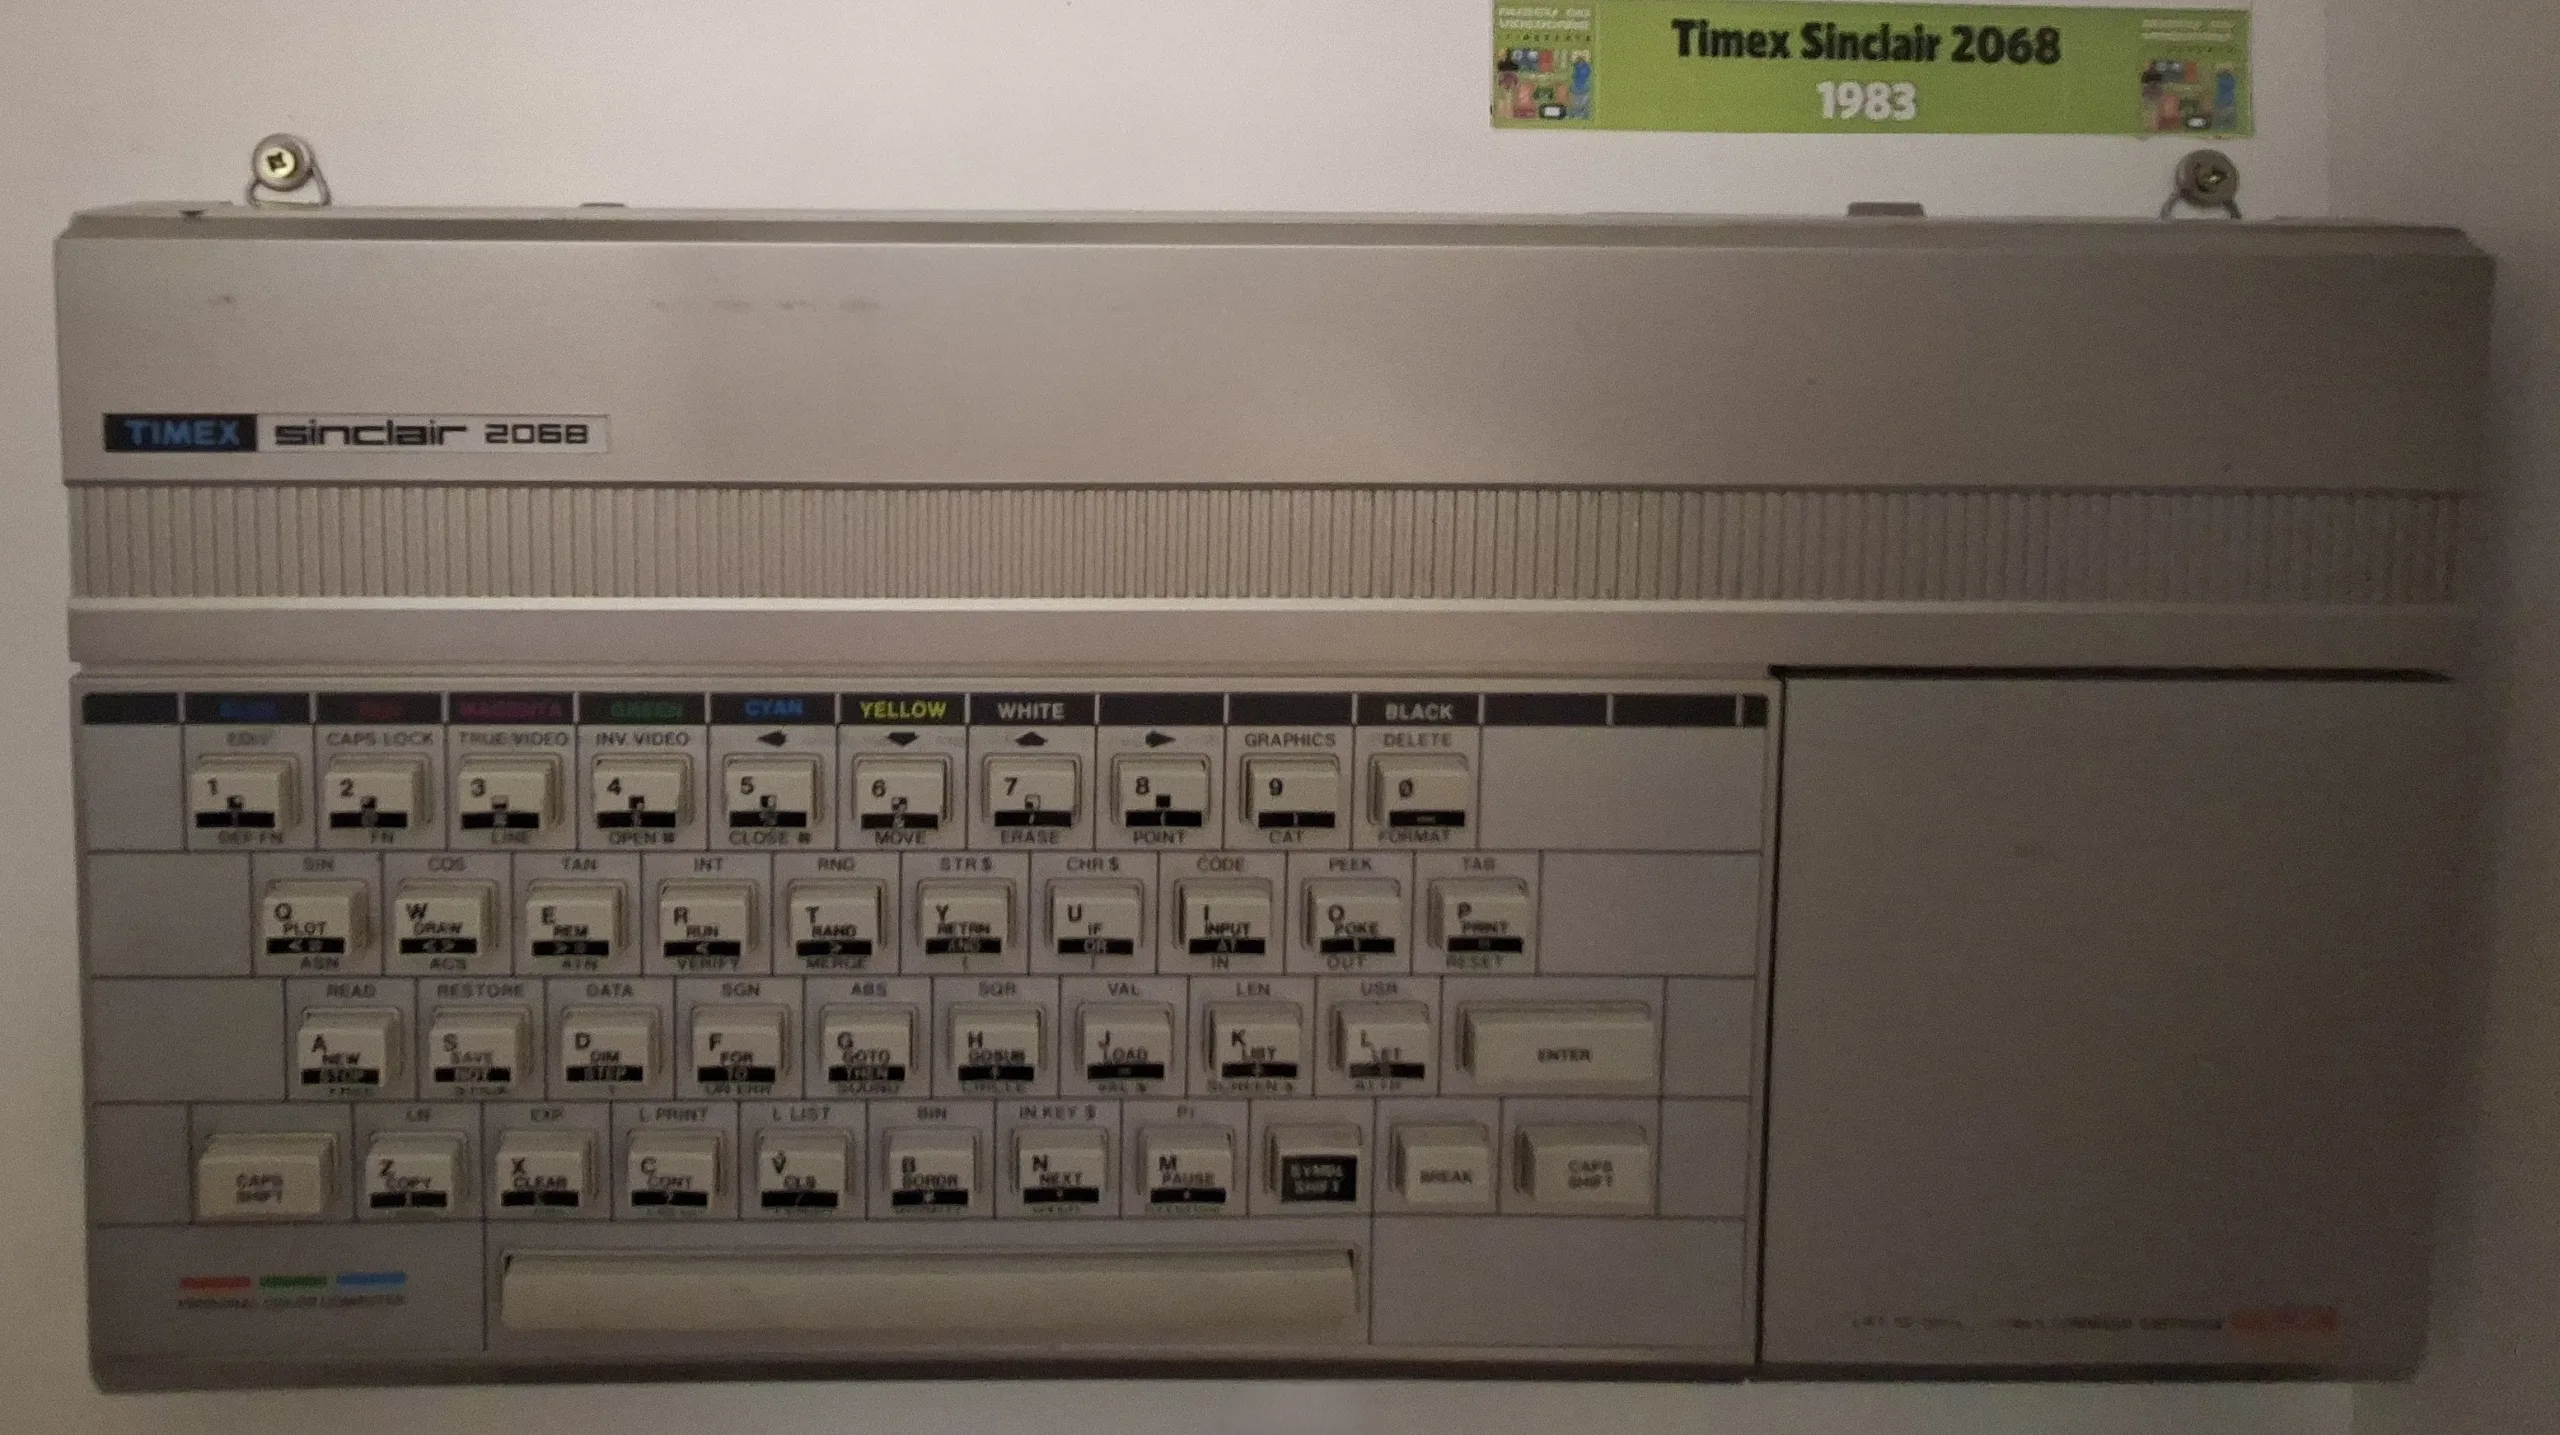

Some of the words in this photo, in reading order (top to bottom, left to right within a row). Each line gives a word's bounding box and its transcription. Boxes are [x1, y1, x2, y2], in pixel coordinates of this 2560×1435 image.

[1672, 19, 1791, 61] Timex
[1801, 20, 1942, 63] Sinclair
[1951, 24, 2062, 66] 2068
[1816, 80, 1917, 121] 1983
[125, 419, 241, 446] TIMEX
[274, 418, 468, 446] sinclair
[484, 423, 590, 445] 2068
[860, 700, 946, 718] YELLOW
[998, 702, 1066, 720] WHITE
[1385, 703, 1454, 720] BLACK
[326, 731, 378, 746] CAPS
[383, 731, 434, 746] LOCK
[511, 731, 569, 747] VIDEO
[633, 731, 690, 746] VIDEO
[1244, 732, 1337, 748] GRAPHICS
[1384, 732, 1451, 747] DELETE
[207, 777, 218, 796] 1
[340, 777, 354, 798] 2
[470, 777, 486, 798] 3
[606, 776, 622, 796] 4
[740, 775, 755, 796] 5
[871, 778, 887, 798] 6
[1003, 776, 1018, 796] 7
[1134, 775, 1150, 796] 8
[1268, 777, 1284, 797] 9
[608, 830, 652, 845] OPEN
[874, 830, 926, 845] MOVE
[1000, 829, 1061, 845] ERASE
[1132, 829, 1186, 844] POINT
[1268, 830, 1304, 844] CAT
[561, 857, 599, 872] TAN
[693, 857, 723, 872] INT
[1196, 857, 1245, 872] CODE
[1328, 857, 1373, 872] PEEK
[405, 902, 428, 921] W
[541, 906, 556, 925] E
[673, 906, 689, 925] R
[805, 906, 820, 924] T
[935, 903, 950, 921] Y
[1067, 903, 1083, 922] U
[1203, 904, 1211, 921] I
[1327, 903, 1346, 923] O
[1457, 901, 1472, 919] P
[282, 921, 327, 937] PLOT
[1088, 922, 1103, 936] IF
[1211, 955, 1230, 970] IN
[586, 982, 635, 998] DATA
[1107, 982, 1140, 997] VAL
[1236, 982, 1271, 997] LEN
[311, 1033, 328, 1053] A
[443, 1032, 459, 1052] S
[575, 1032, 591, 1050] D
[708, 1032, 724, 1052] F
[967, 1030, 984, 1048] H
[1098, 1029, 1112, 1048] J
[1230, 1028, 1247, 1048] K
[379, 1158, 395, 1177] Z
[511, 1157, 527, 1175] X
[640, 1156, 657, 1174] C
[771, 1153, 787, 1174] V
[1032, 1154, 1049, 1172] N
[1158, 1154, 1178, 1172] M
